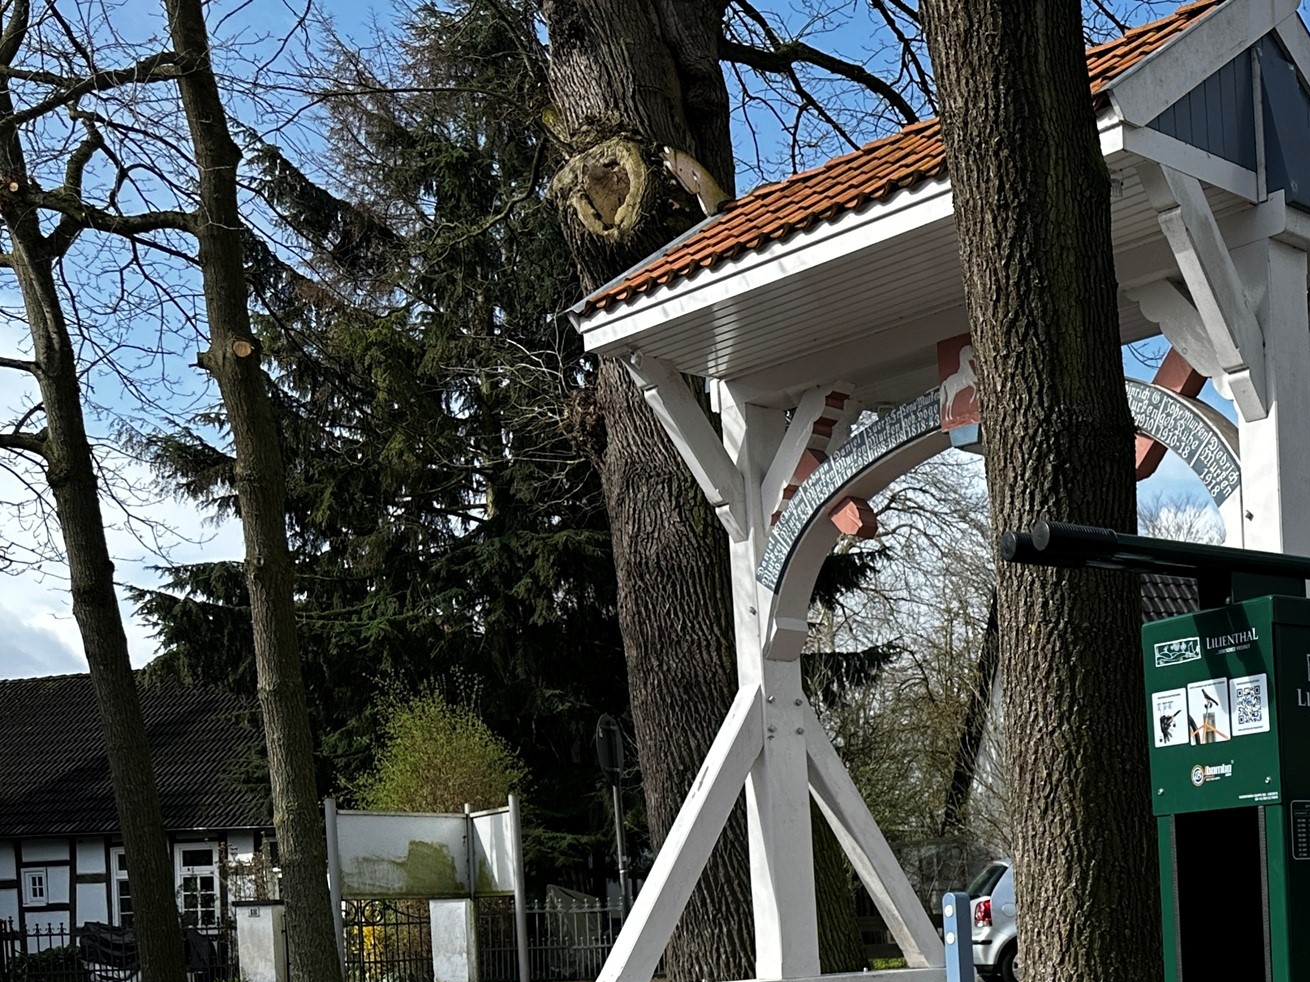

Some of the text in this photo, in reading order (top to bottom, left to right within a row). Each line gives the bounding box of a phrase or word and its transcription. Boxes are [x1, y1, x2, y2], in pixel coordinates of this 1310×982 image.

[833, 434, 860, 462] Daniel
[1208, 437, 1239, 485] Diedrich
[1200, 447, 1232, 497] Murken
[1200, 468, 1220, 497] 1918
[757, 536, 775, 576] Daniel
